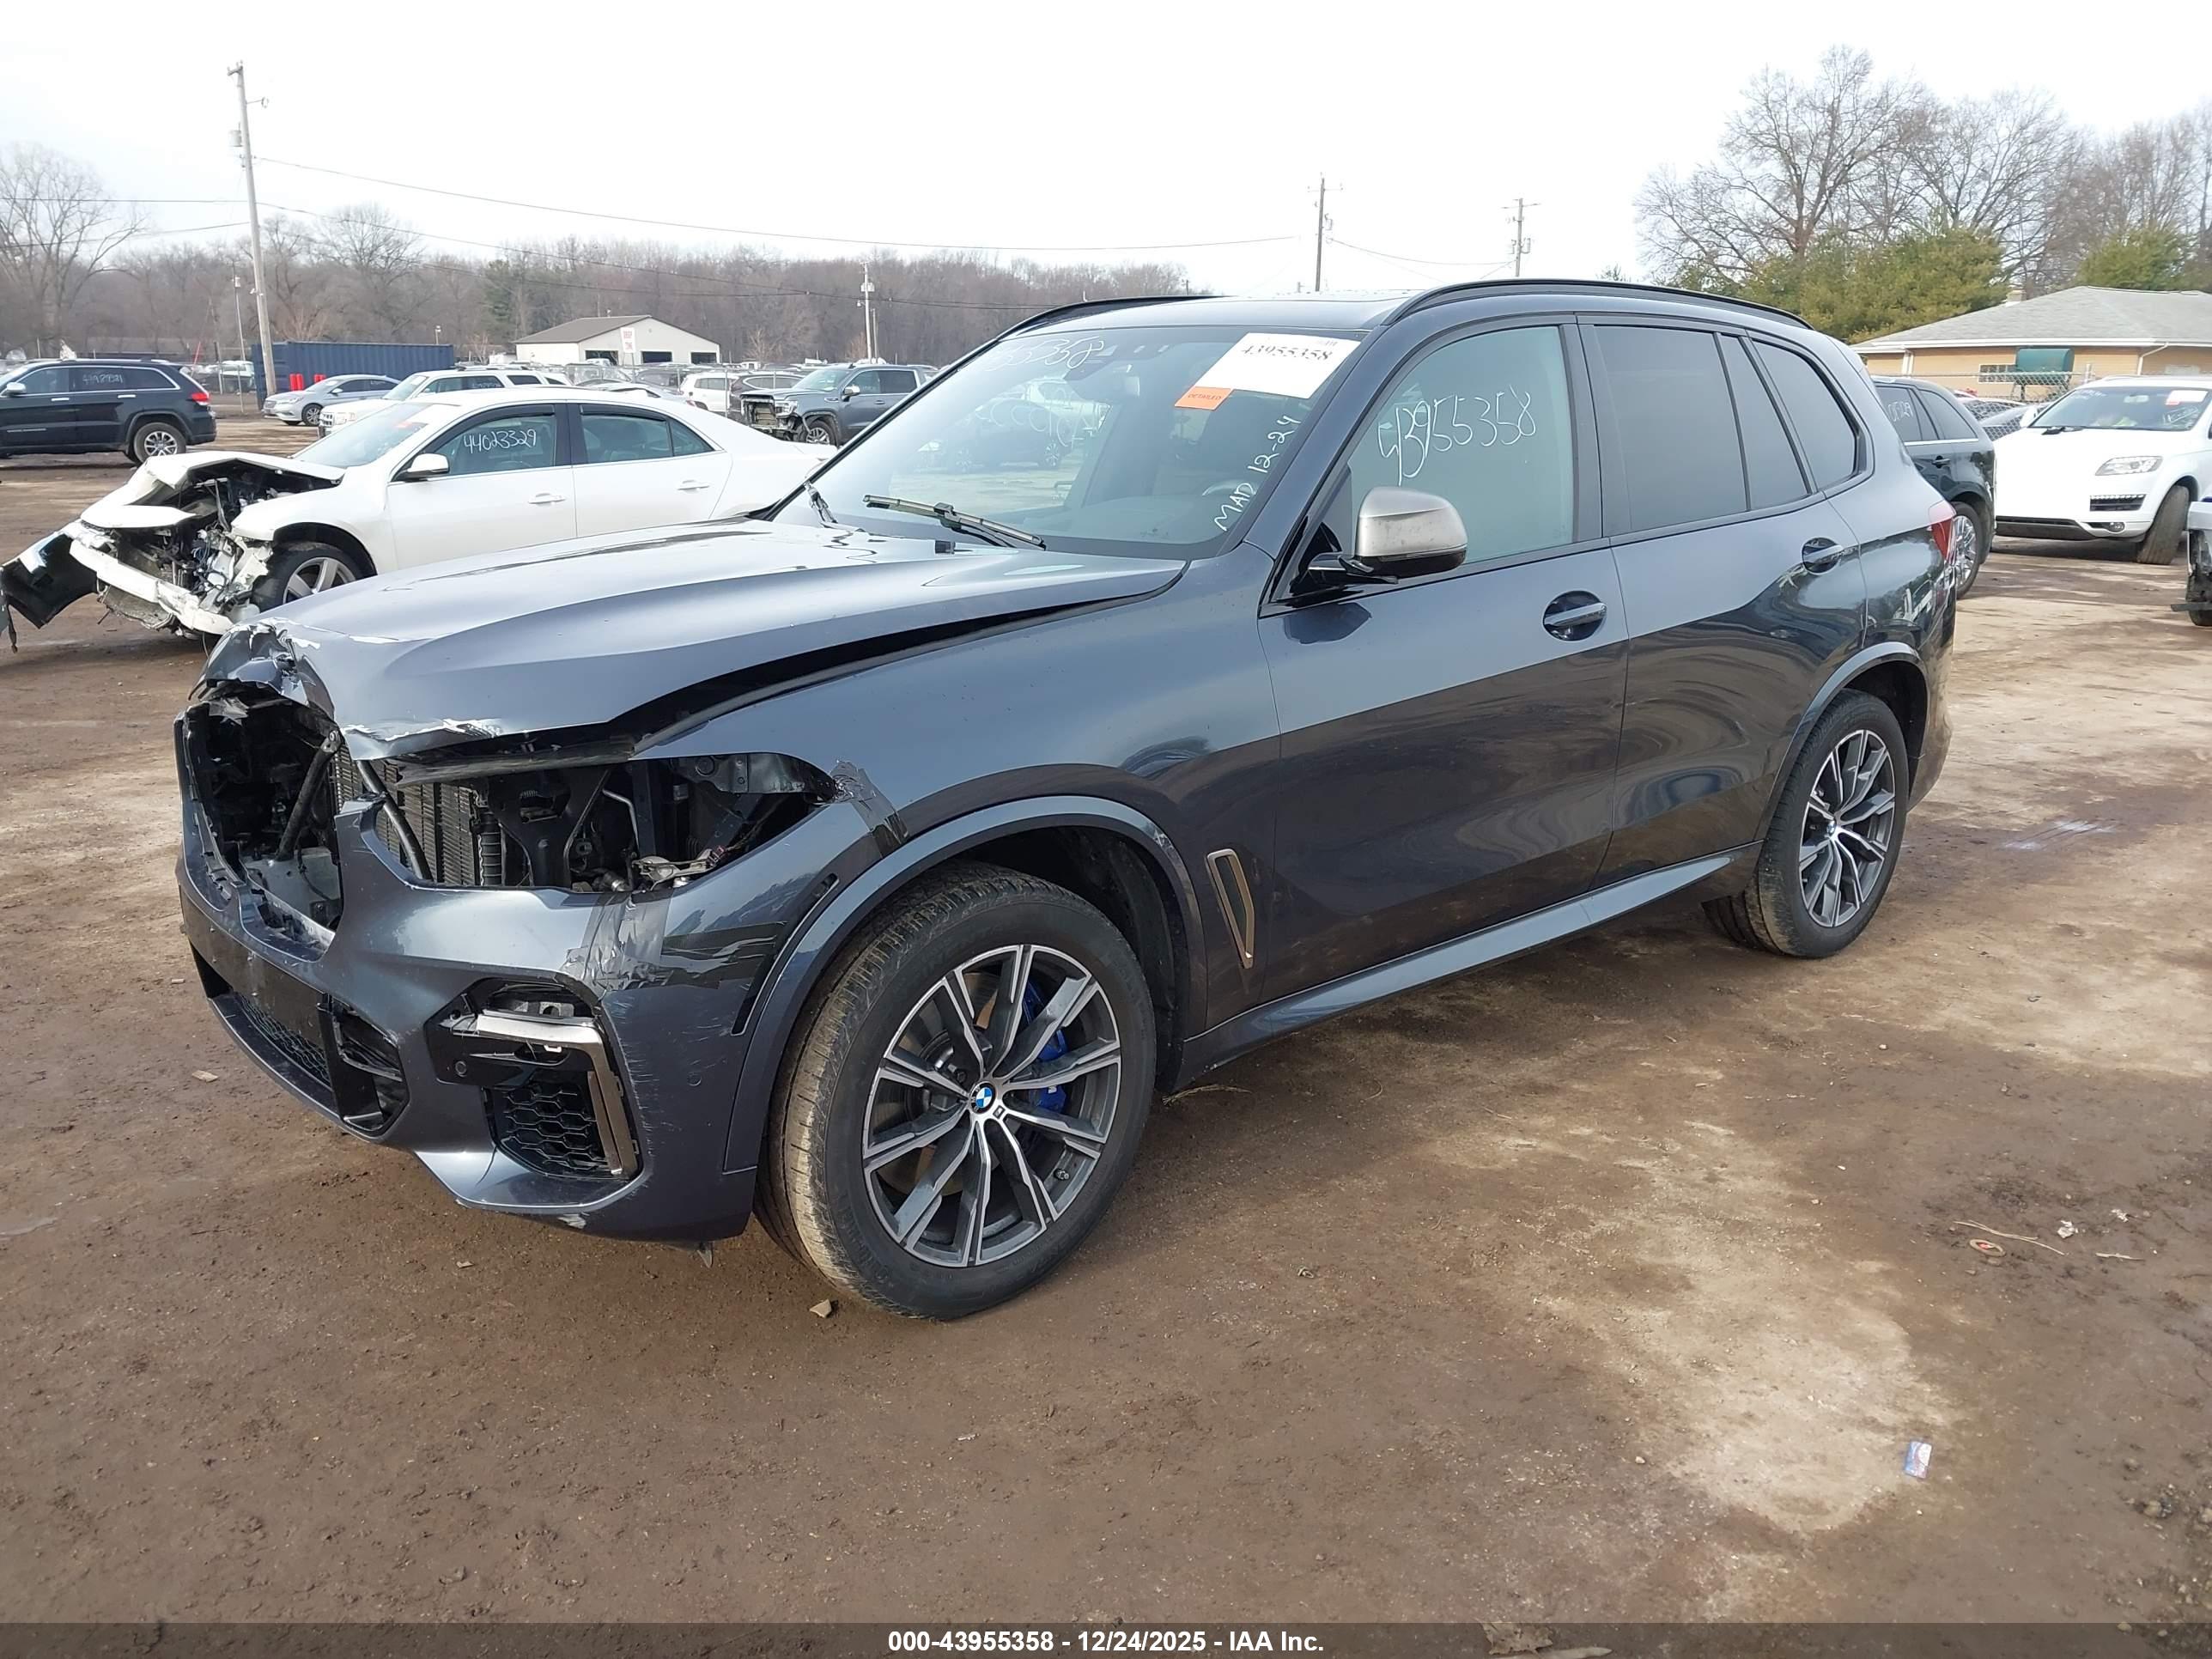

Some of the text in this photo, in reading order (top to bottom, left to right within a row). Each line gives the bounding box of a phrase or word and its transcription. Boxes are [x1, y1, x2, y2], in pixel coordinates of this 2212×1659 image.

[464, 428, 537, 454] 44023329
[1213, 415, 1302, 532] MAD 12-24
[1378, 385, 1536, 486] 43955358
